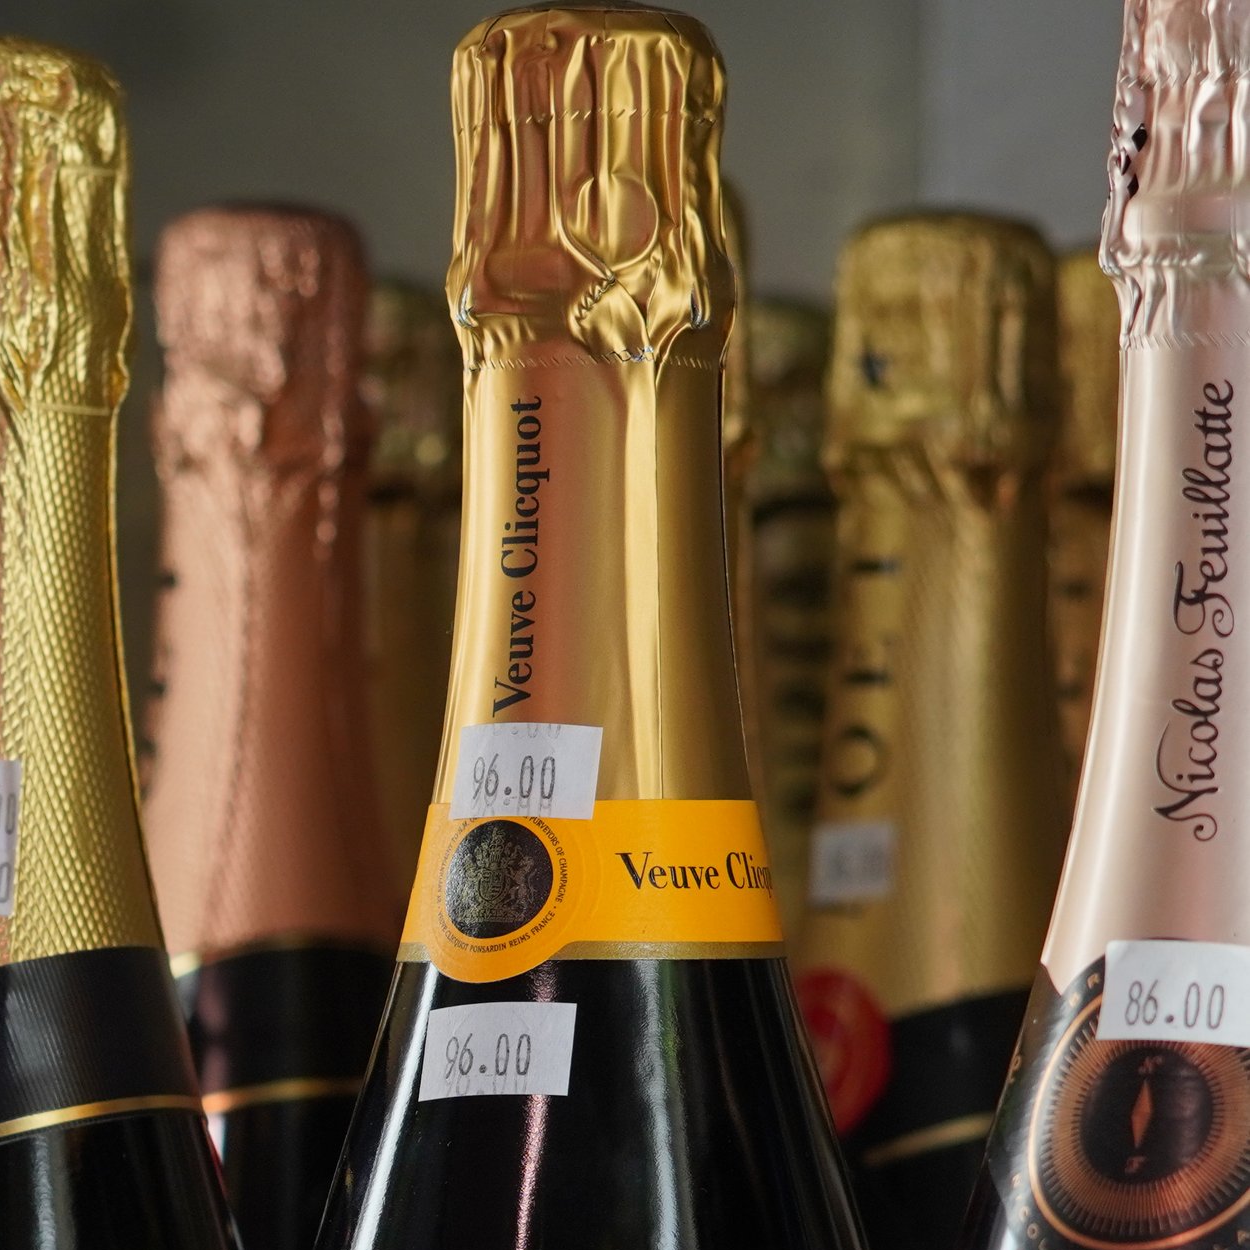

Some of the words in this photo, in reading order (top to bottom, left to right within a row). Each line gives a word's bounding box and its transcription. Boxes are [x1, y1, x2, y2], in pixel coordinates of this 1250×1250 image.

[501, 395, 551, 580] Clicquot
[1173, 378, 1235, 639] Feuillatte
[492, 590, 537, 718] Veuve
[1153, 647, 1225, 843] Nicolas
[472, 753, 556, 800] 96.00
[556, 846, 565, 858] OF
[616, 852, 721, 890] Veuve
[557, 857, 569, 904] CHAMPAGNE
[470, 941, 507, 953] PONSARDIN
[509, 933, 531, 947] REIMS
[530, 910, 556, 936] FRANCE
[1125, 979, 1225, 1030] 86.00
[445, 1033, 532, 1080] 96.00
